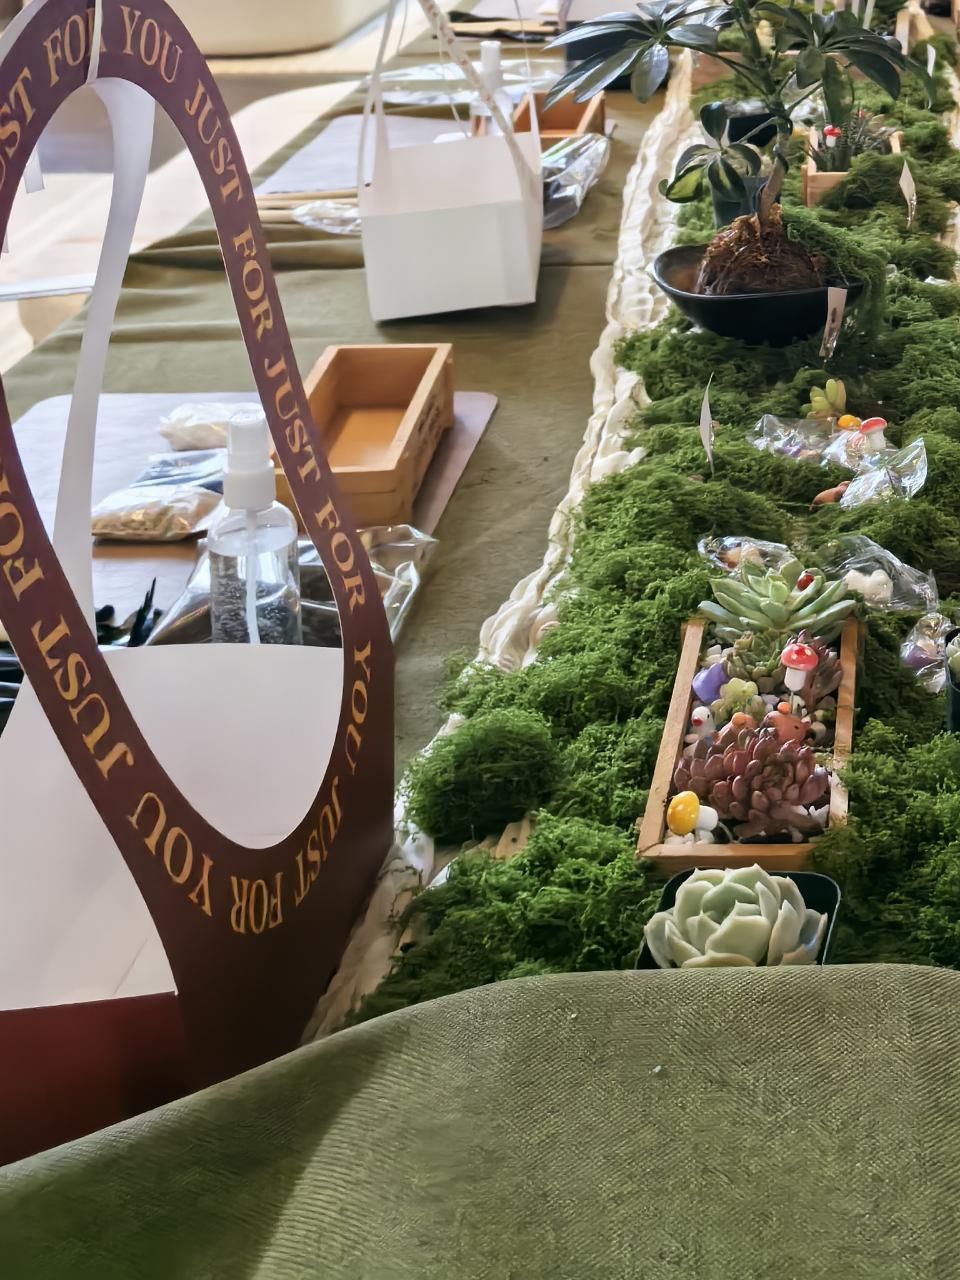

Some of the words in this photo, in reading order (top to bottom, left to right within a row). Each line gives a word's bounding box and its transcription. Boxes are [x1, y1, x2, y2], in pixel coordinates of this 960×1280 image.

[120, 5, 183, 84] YOU
[184, 79, 244, 205] JUST
[233, 223, 273, 341] FOR
[264, 353, 320, 484] JUST
[314, 496, 366, 614] FOR
[31, 615, 134, 779] JUST
[345, 640, 371, 776] YOU
[128, 791, 214, 917] YOU
[230, 872, 284, 935] FOR
[294, 776, 343, 907] JUST
